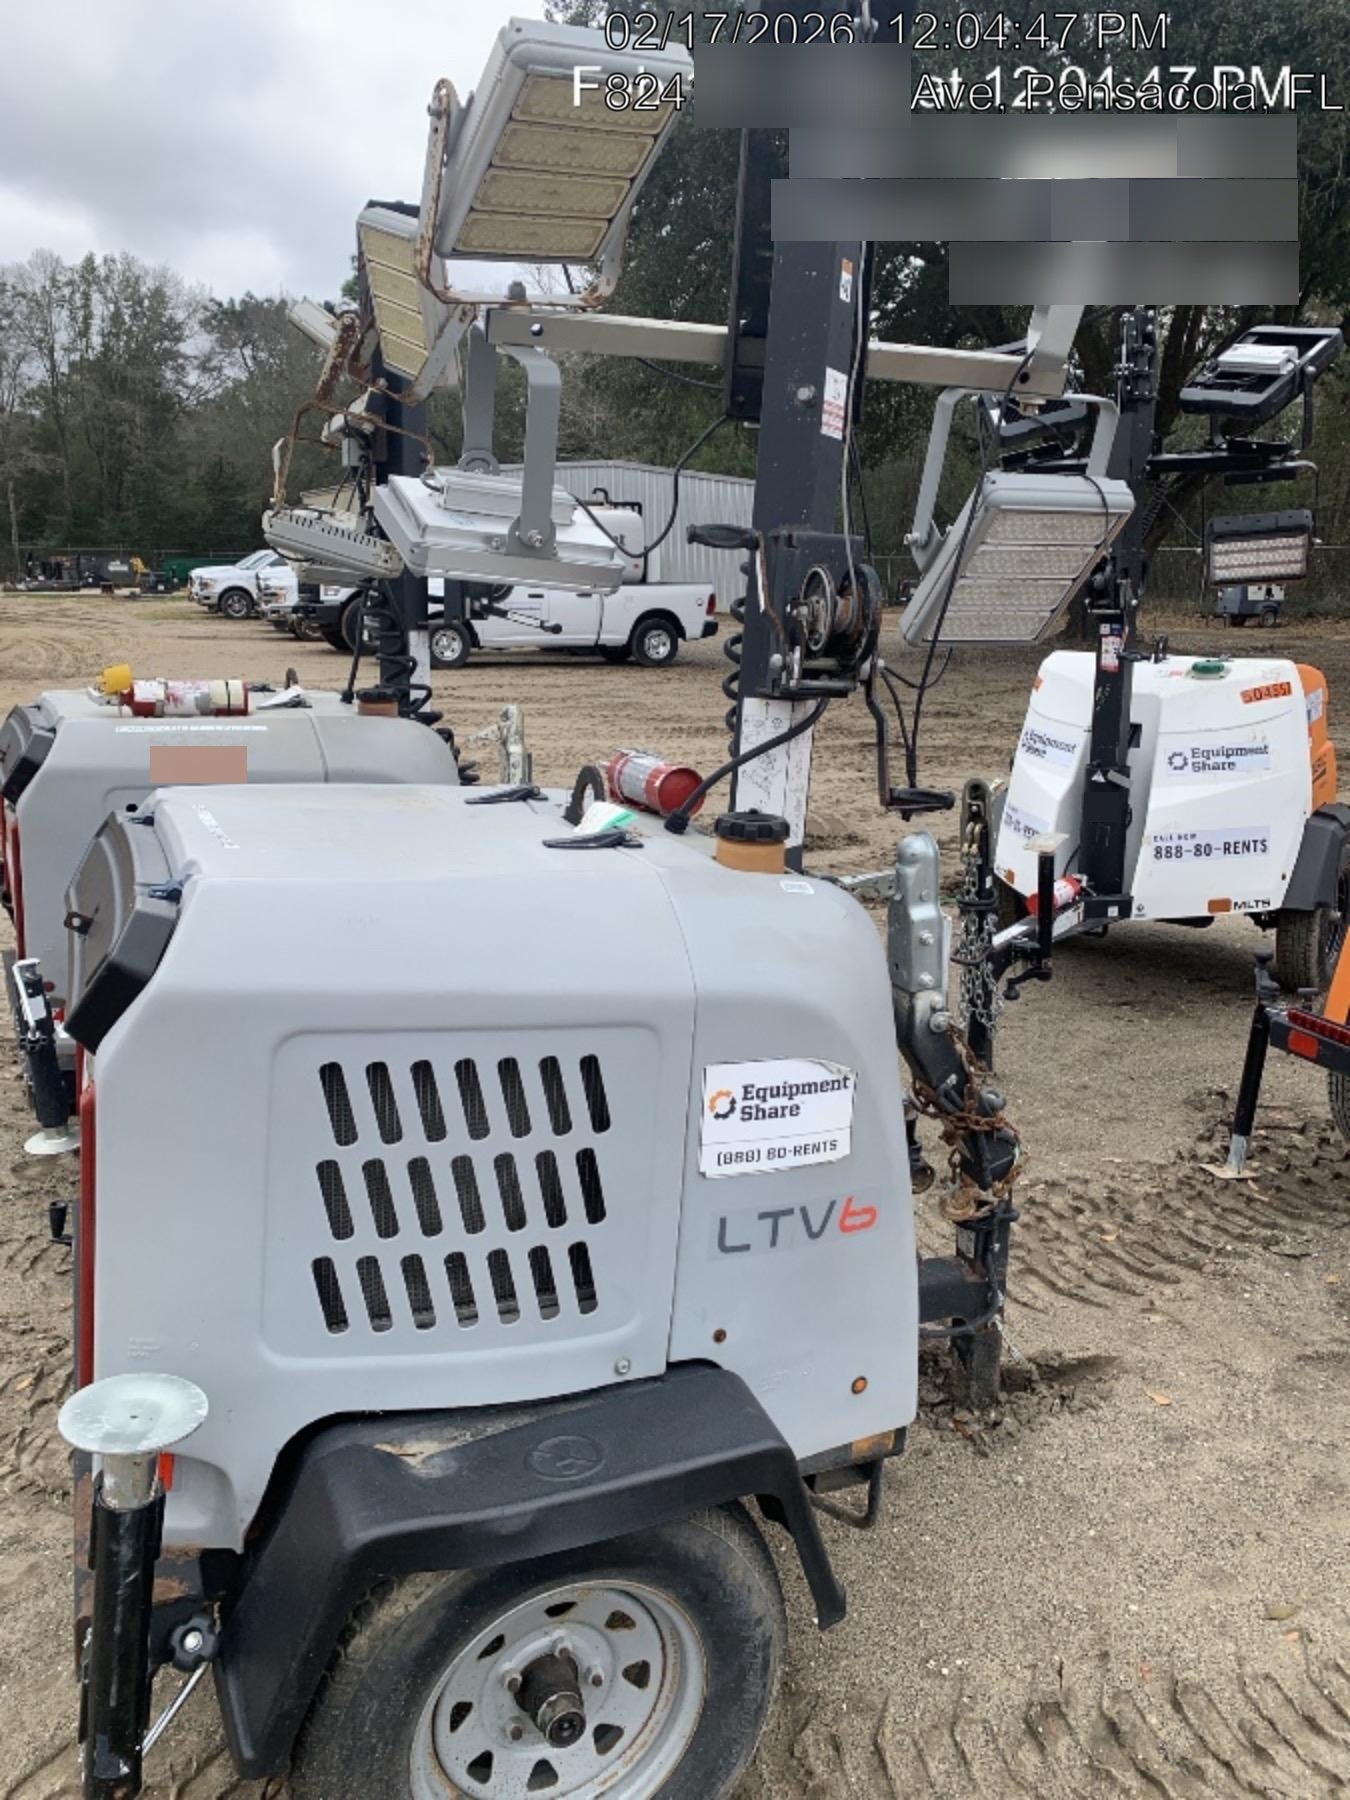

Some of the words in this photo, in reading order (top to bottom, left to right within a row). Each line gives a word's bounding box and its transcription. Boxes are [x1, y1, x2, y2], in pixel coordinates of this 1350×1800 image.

[1191, 744, 1269, 760] Equipment
[1191, 761, 1236, 773] Share
[1153, 839, 1268, 860] 888-80-RENTS
[741, 1075, 851, 1103] Equipment
[740, 1103, 801, 1122] Share
[716, 1151, 762, 1166] (888)
[766, 1139, 837, 1161] 80-RENTS
[717, 1195, 877, 1254] LTV6
